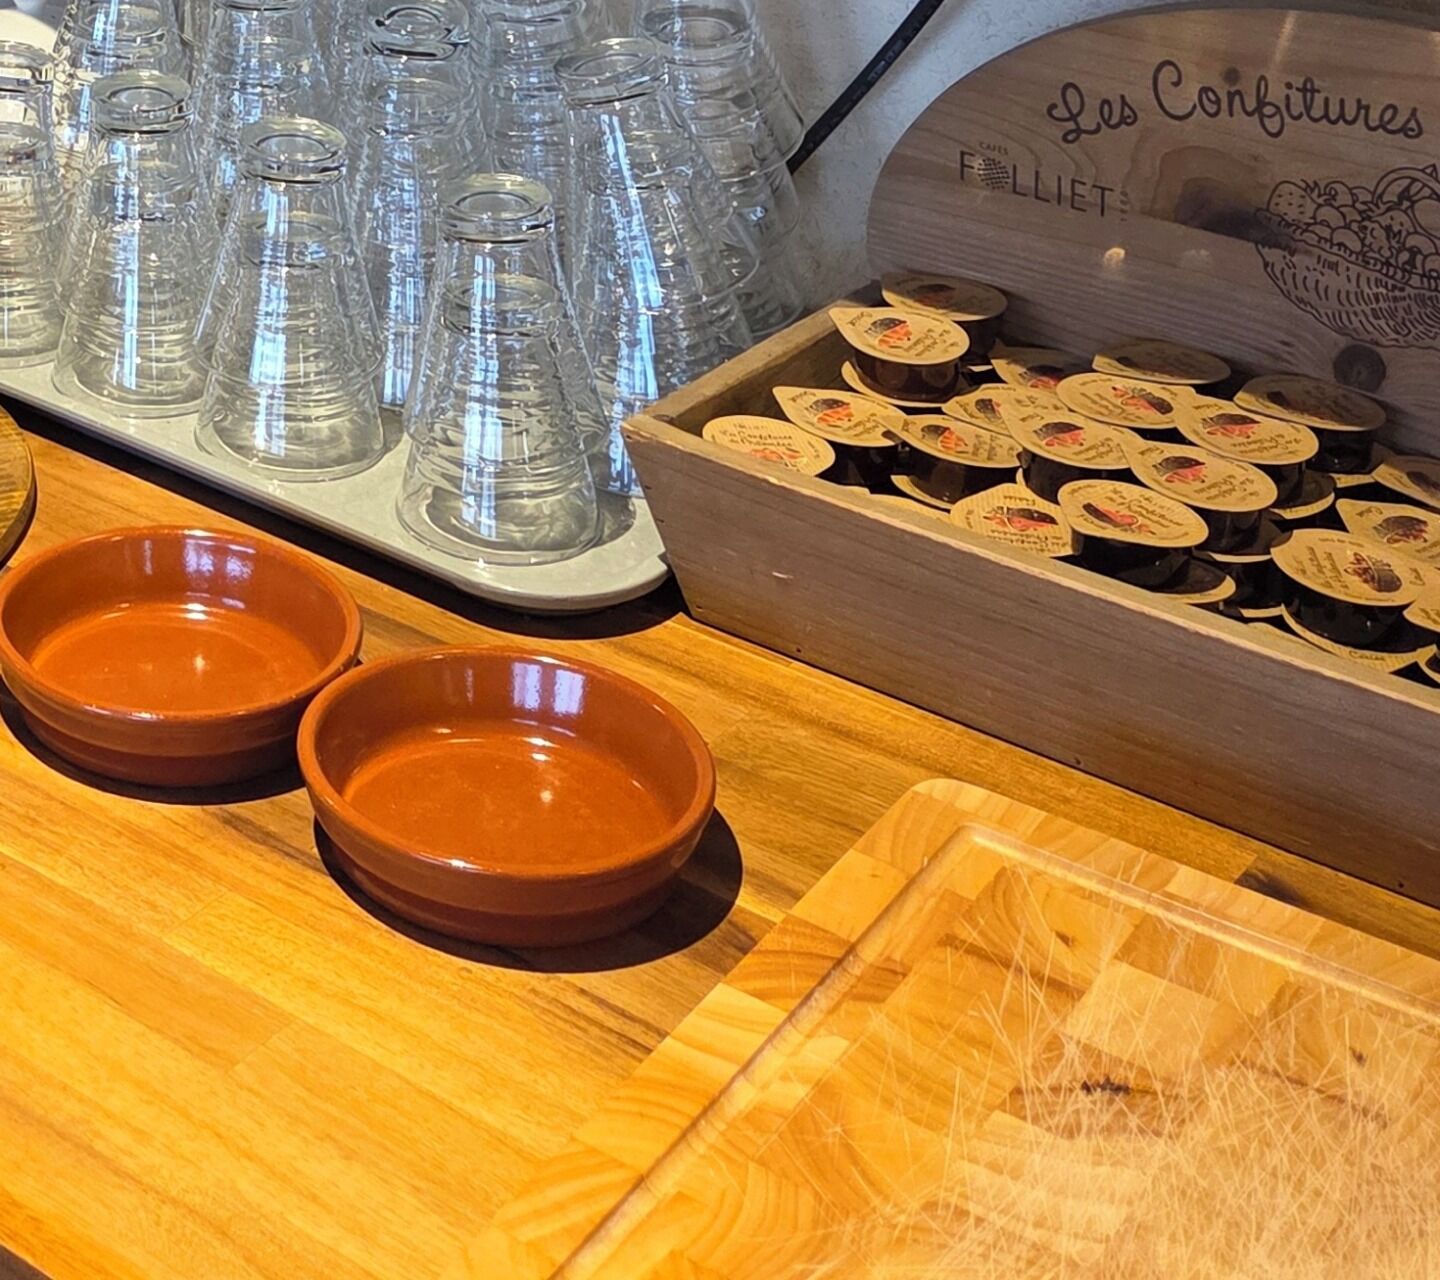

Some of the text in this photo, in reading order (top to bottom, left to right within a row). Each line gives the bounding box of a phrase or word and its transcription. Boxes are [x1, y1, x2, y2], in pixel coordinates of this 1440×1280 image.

[1046, 59, 1425, 144] Les Confitures
[959, 150, 1115, 217] FOLLIET
